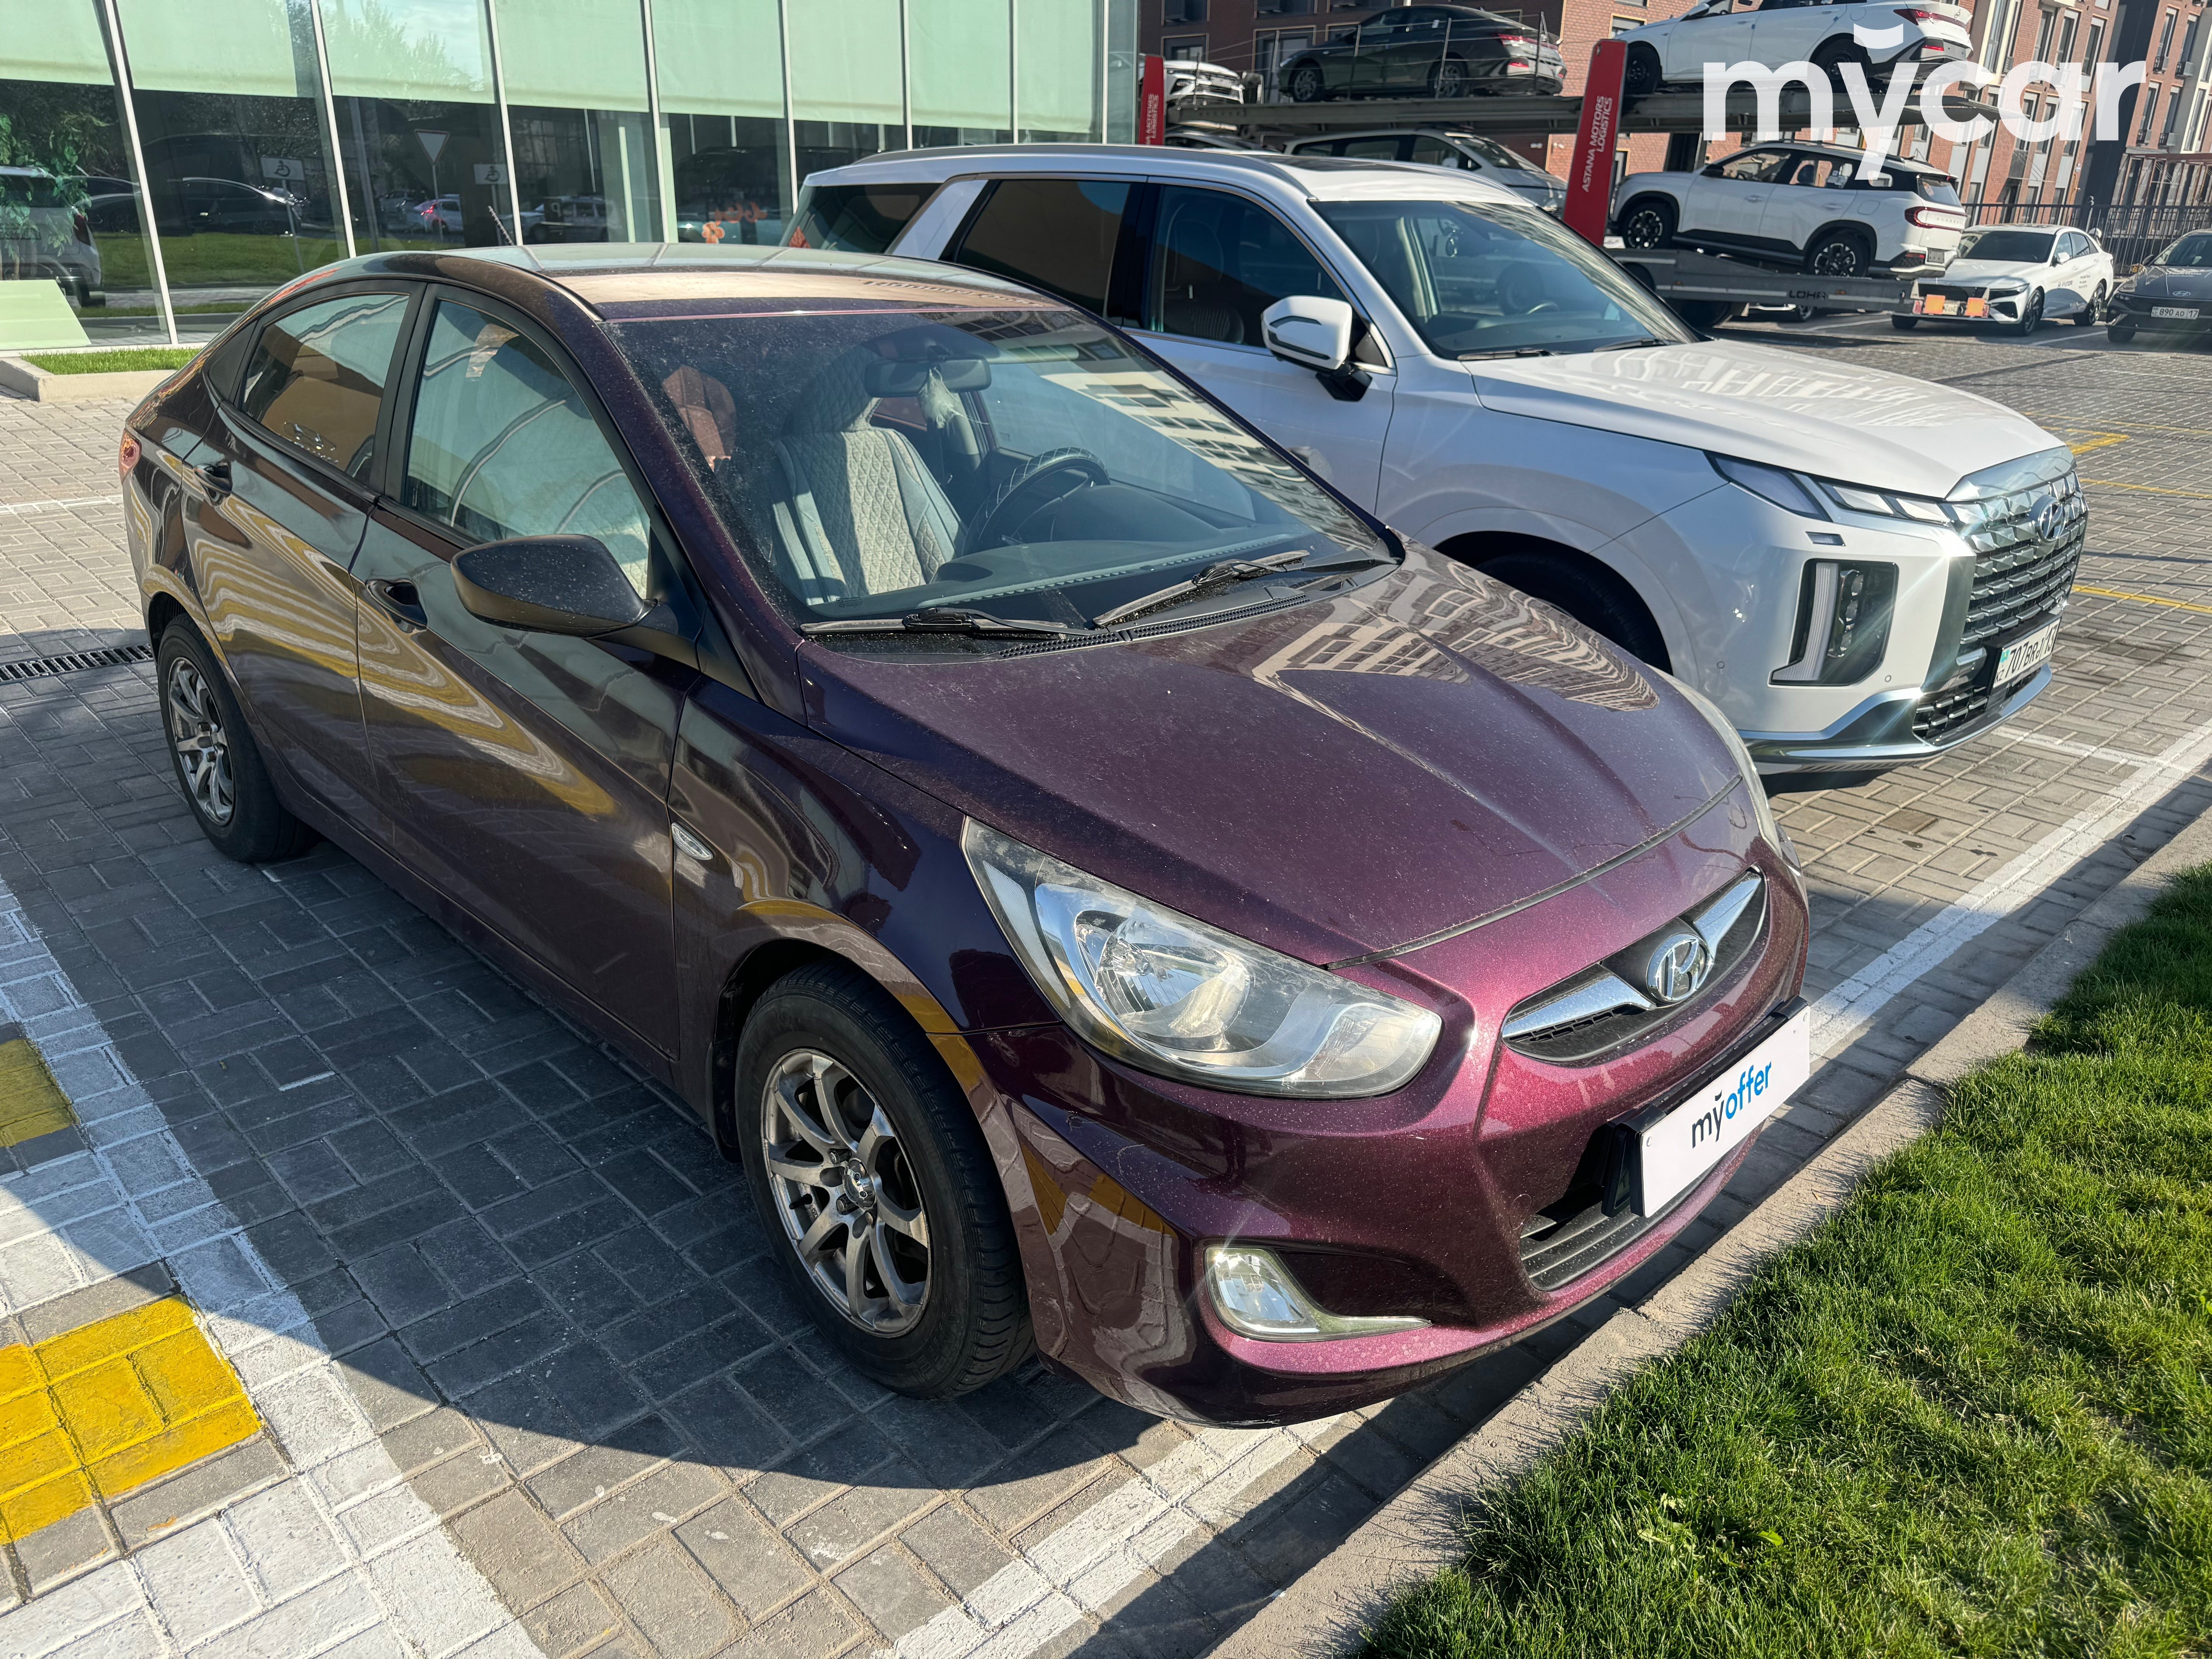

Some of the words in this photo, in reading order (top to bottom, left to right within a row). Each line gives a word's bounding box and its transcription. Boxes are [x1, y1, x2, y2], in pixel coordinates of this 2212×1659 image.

[1582, 148, 1596, 192] ASTANA
[1589, 95, 1605, 146] MOTORS
[1597, 97, 1613, 152] LOGISTICS
[1692, 1061, 1772, 1149] myoffer
